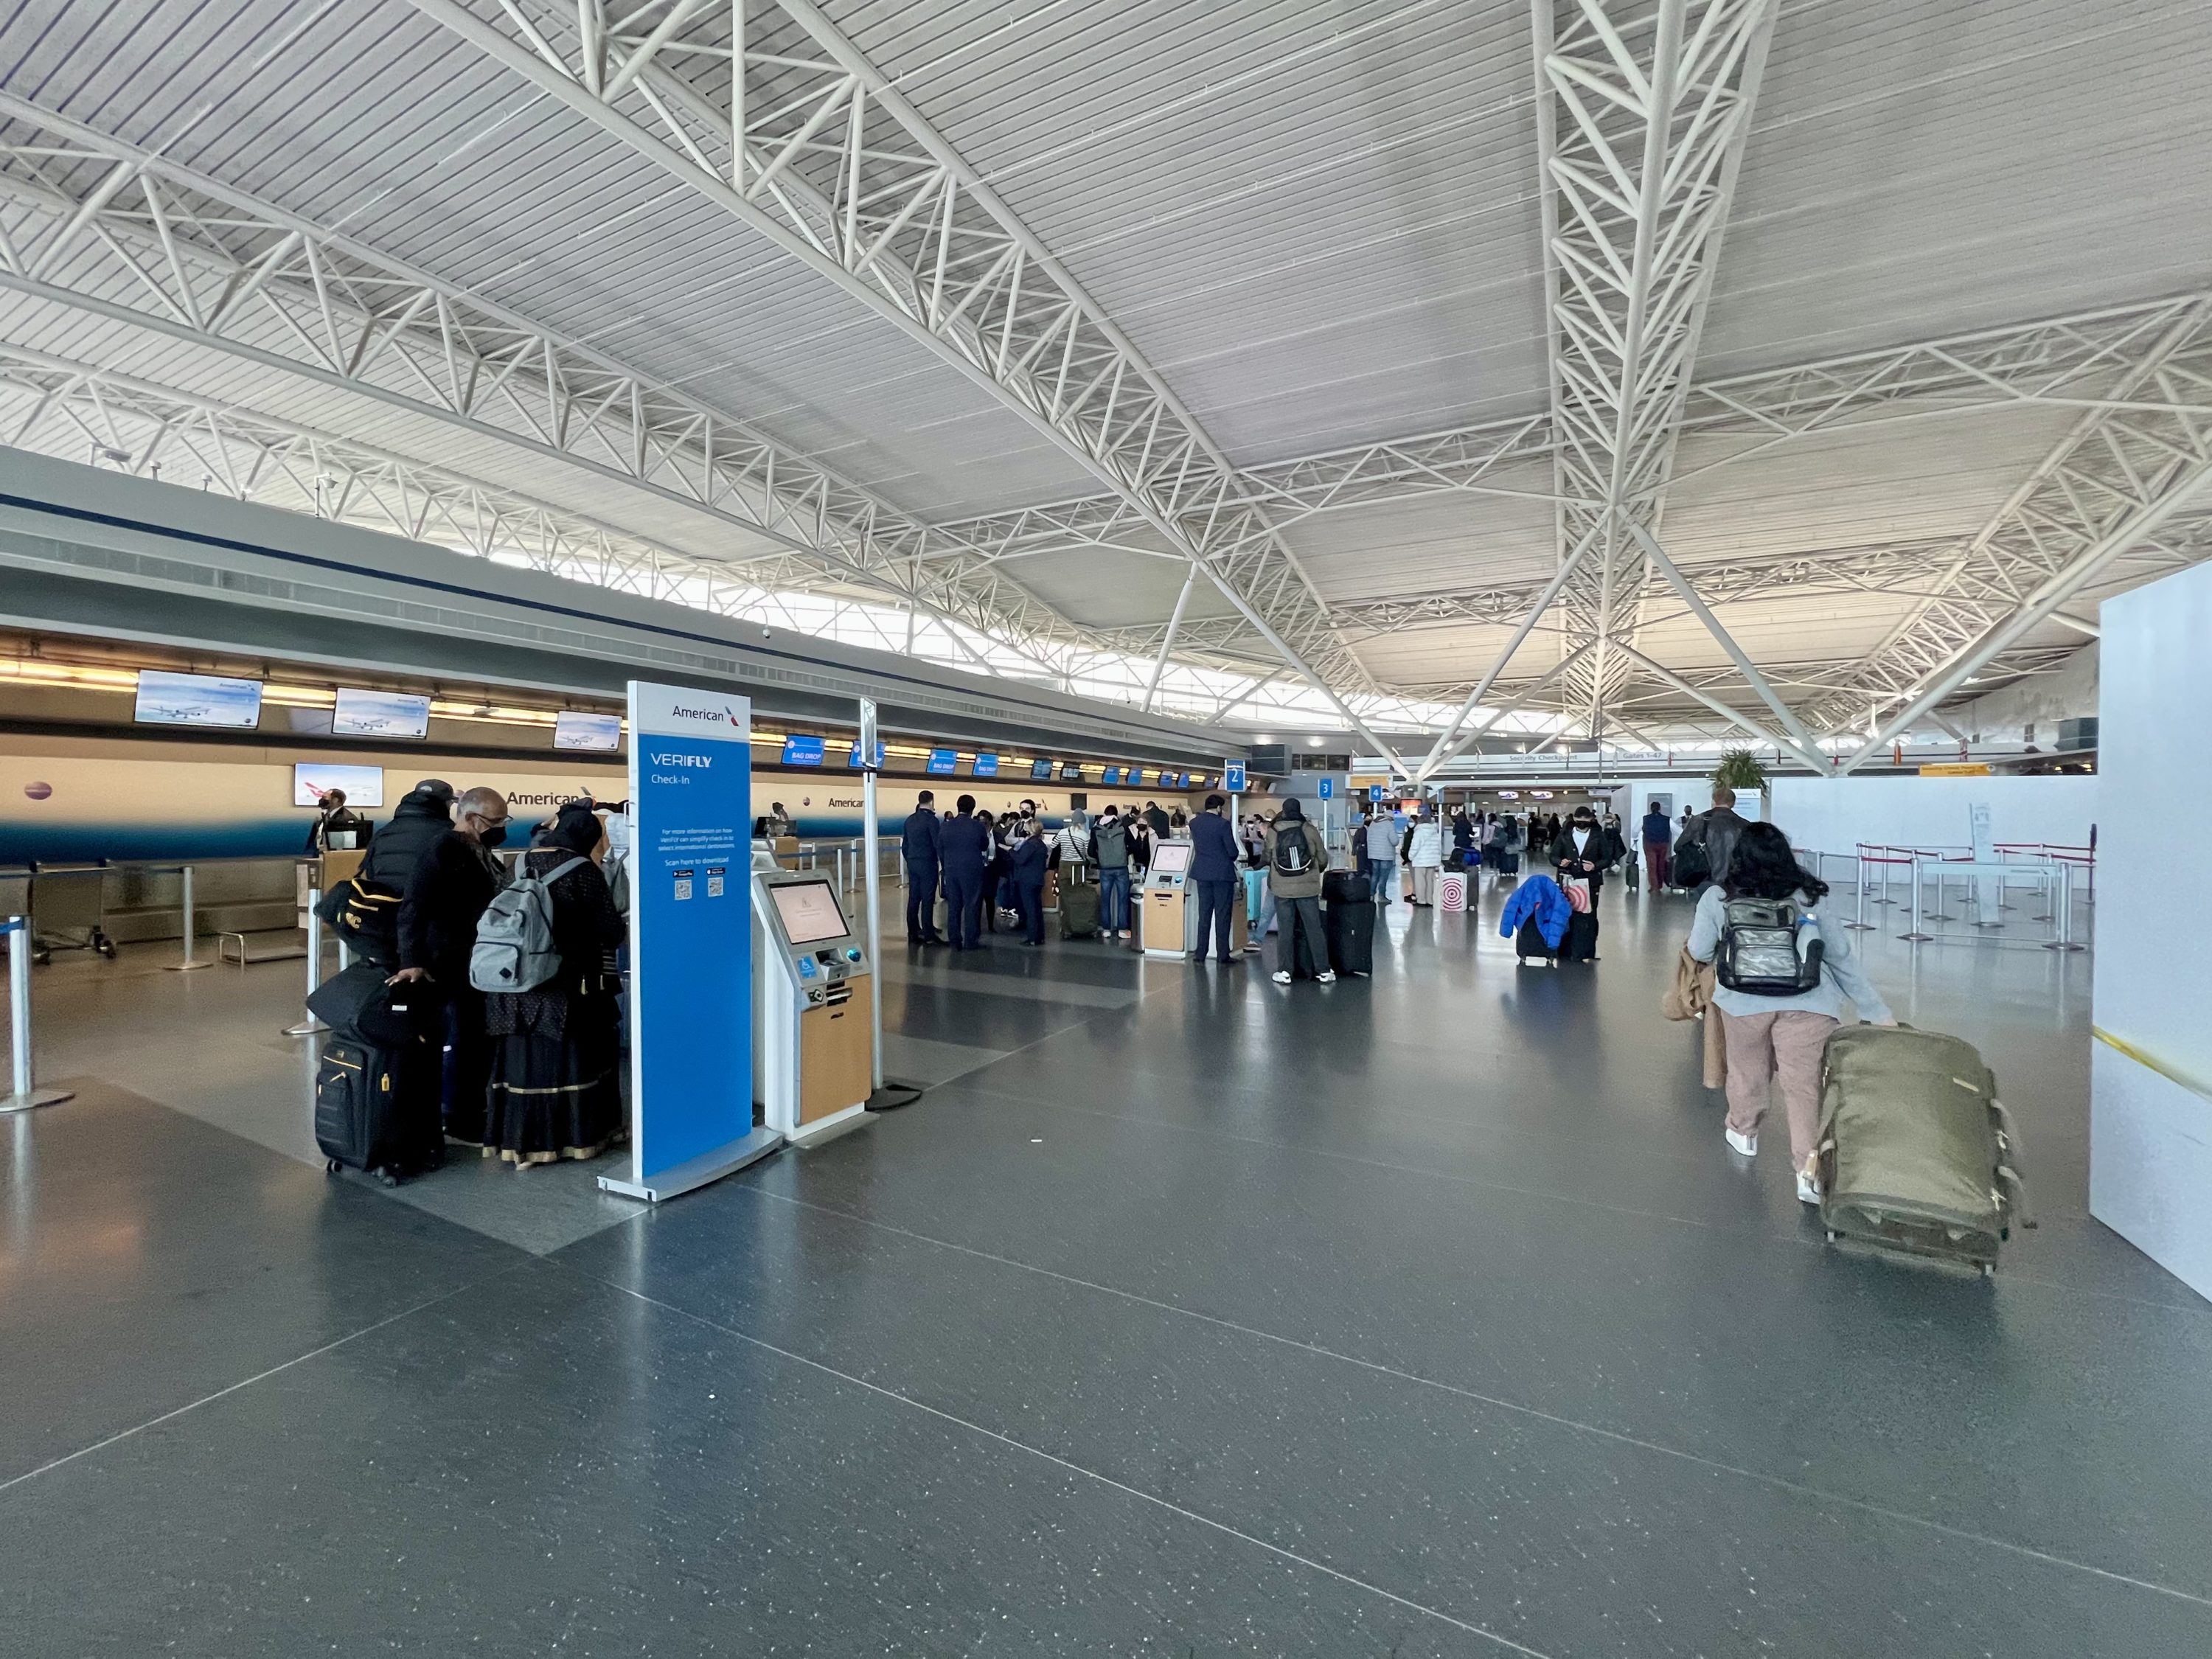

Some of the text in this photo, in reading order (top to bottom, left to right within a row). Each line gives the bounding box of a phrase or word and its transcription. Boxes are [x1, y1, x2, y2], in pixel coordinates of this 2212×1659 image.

[672, 706, 724, 722] American
[650, 753, 712, 768] VERIFLY
[651, 774, 690, 785] Check-In
[1231, 768, 1239, 782] 2
[1323, 783, 1329, 793] 3
[1373, 789, 1379, 797] 4
